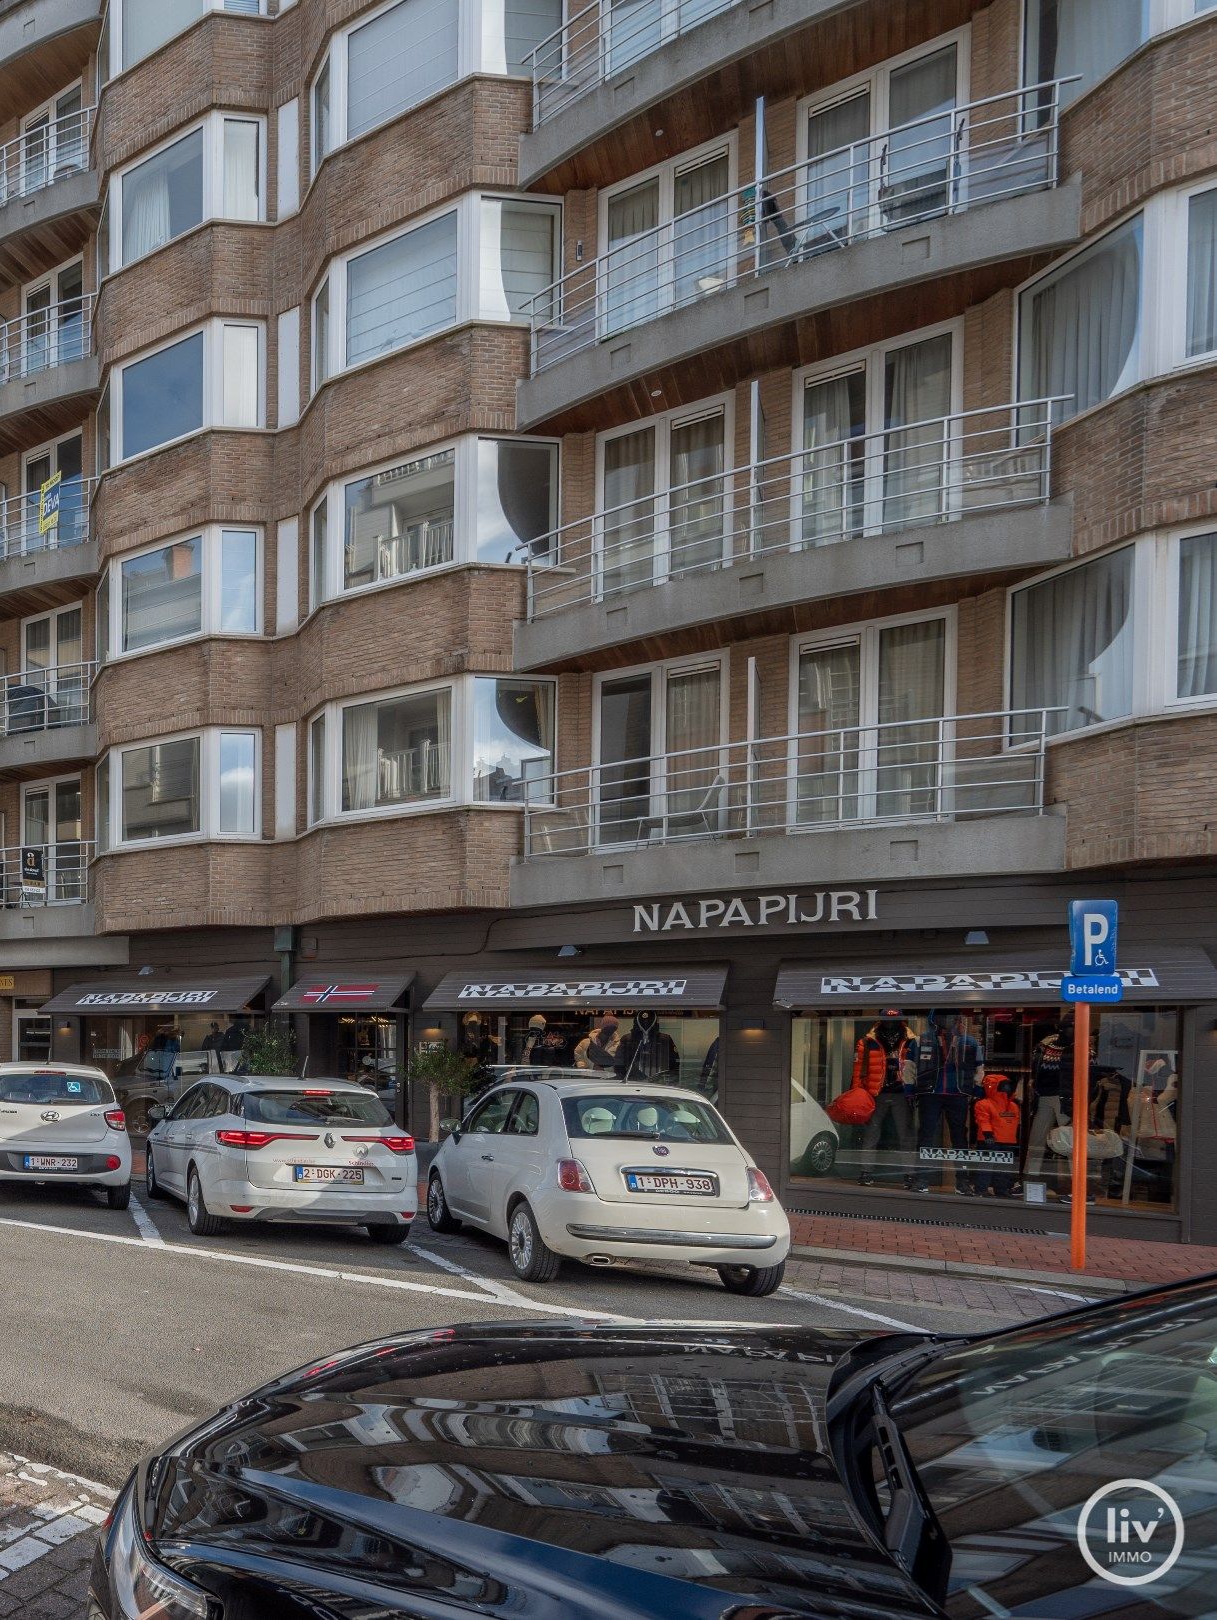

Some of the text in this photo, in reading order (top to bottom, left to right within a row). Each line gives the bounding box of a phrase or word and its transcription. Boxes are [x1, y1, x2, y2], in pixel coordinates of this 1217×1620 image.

[633, 889, 878, 932] NAPAPIJRI
[1084, 913, 1108, 966] P
[465, 981, 680, 997] NAPAPIJRI
[828, 970, 1144, 992] NAPAPII
[1067, 983, 1118, 995] Betalend
[80, 991, 215, 1004] NAPAPIJRI
[922, 1148, 1011, 1162] NAPAPIJRI
